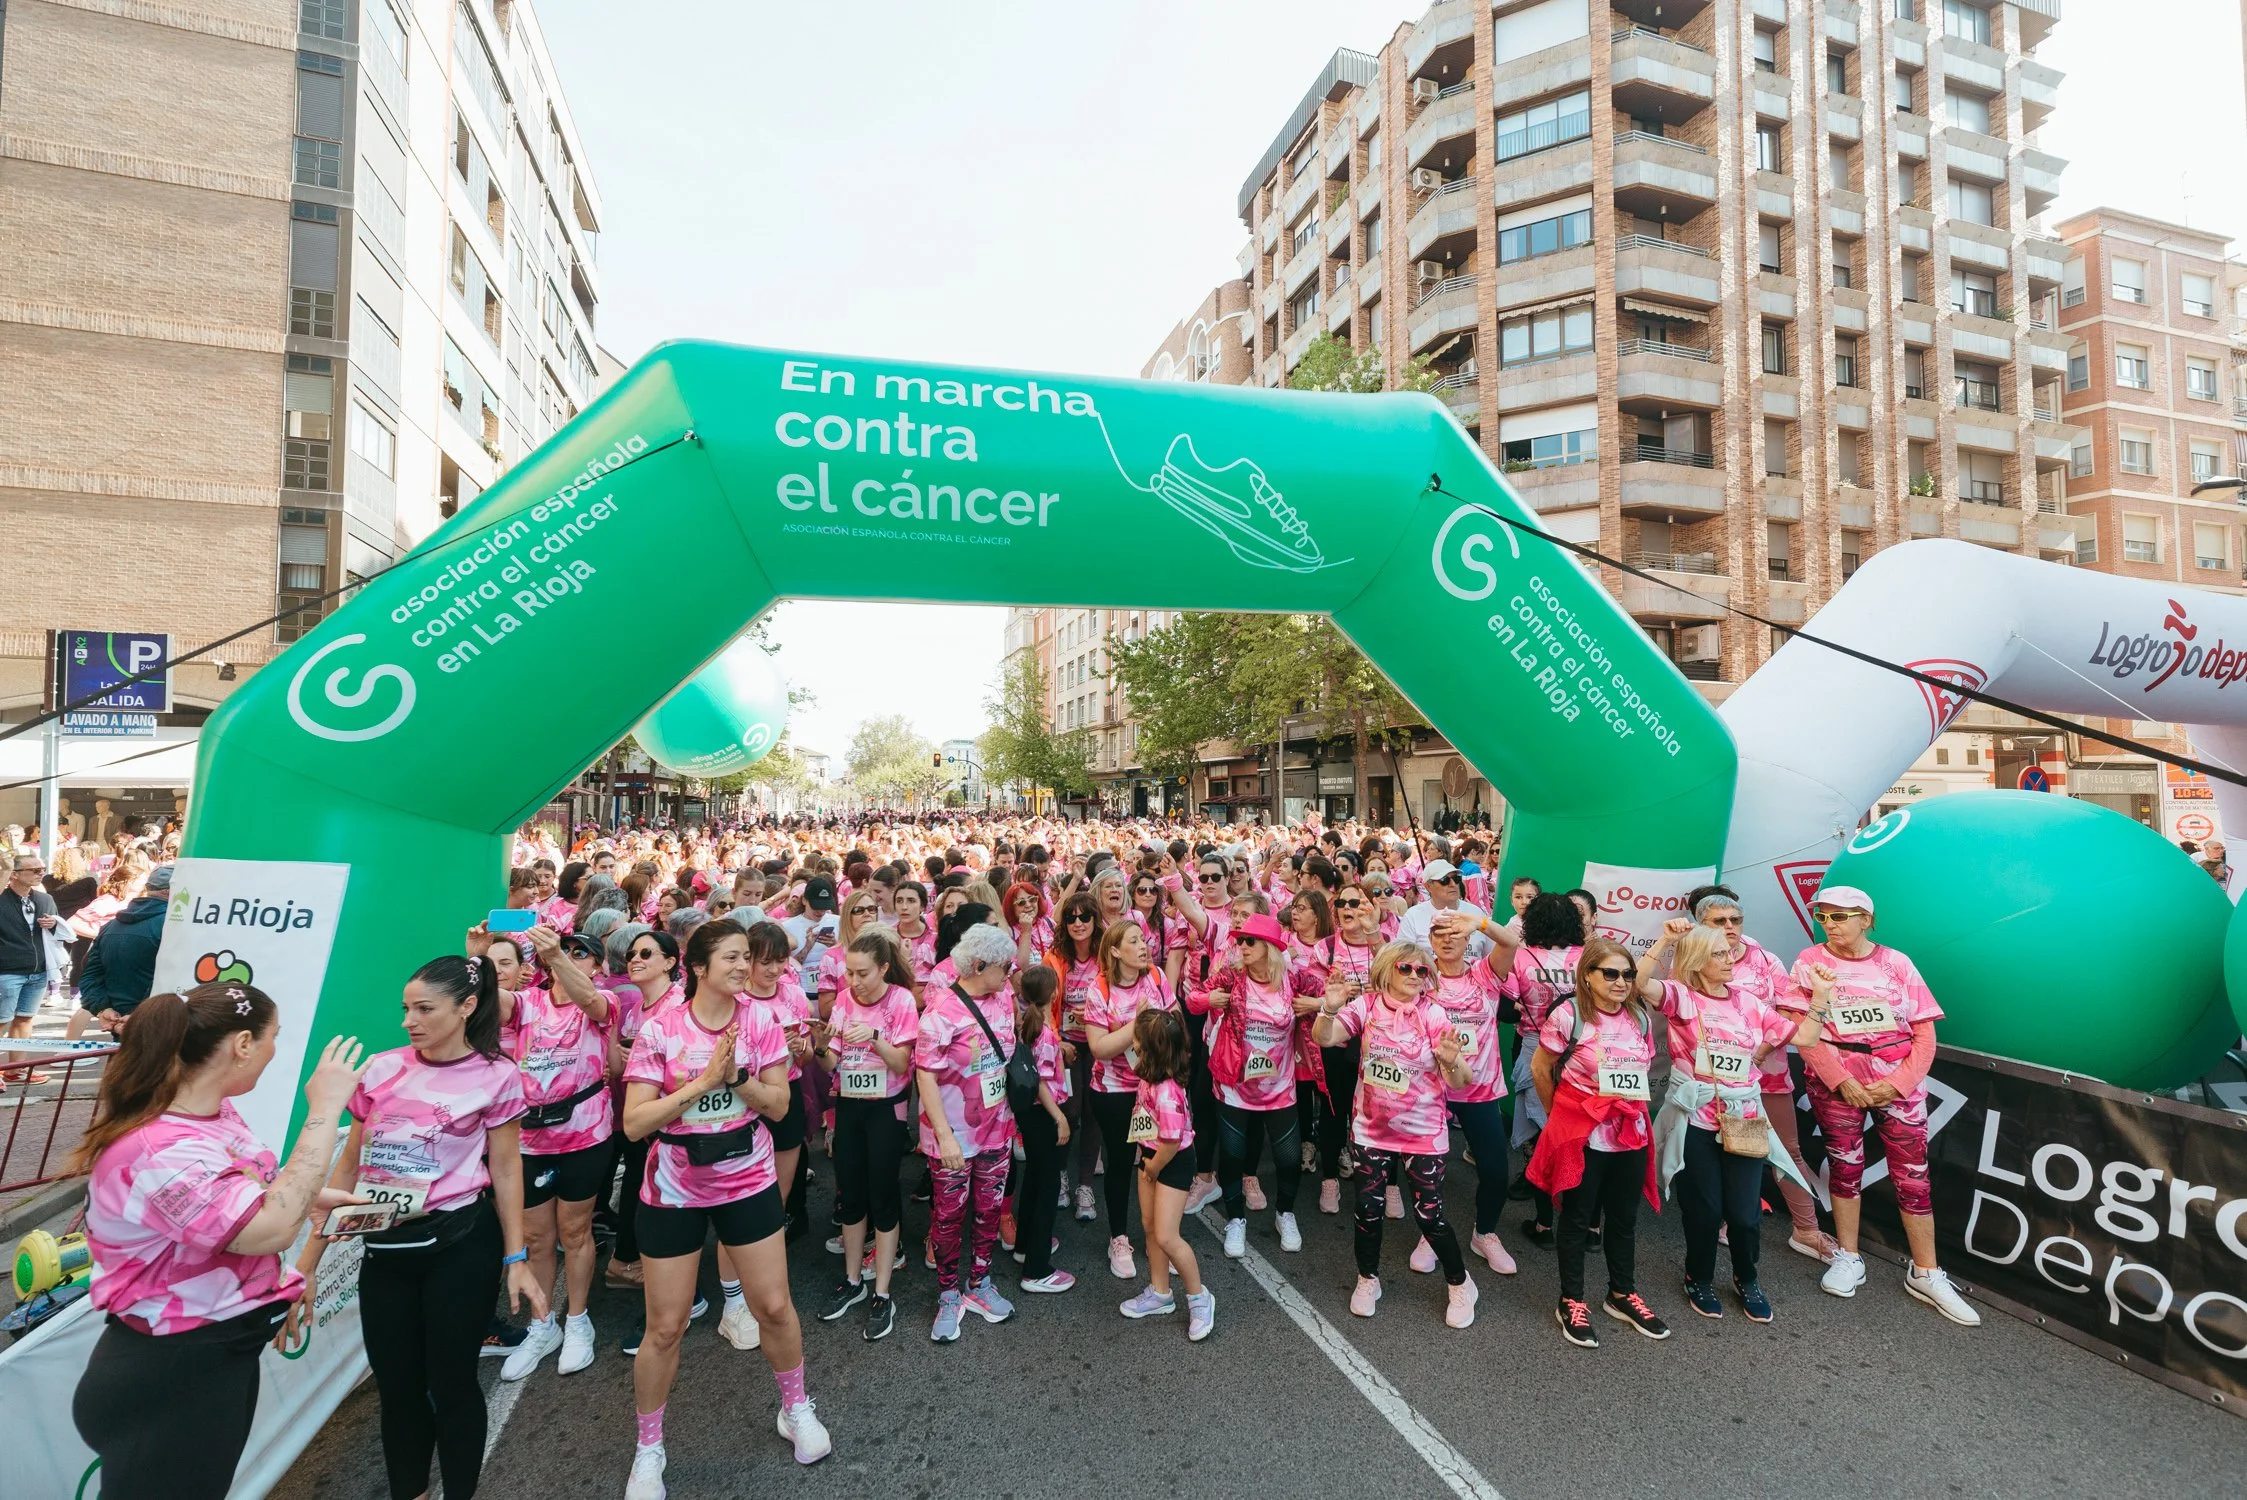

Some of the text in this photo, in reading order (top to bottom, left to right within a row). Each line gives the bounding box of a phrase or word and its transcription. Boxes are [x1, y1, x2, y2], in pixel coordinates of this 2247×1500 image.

[780, 360, 1099, 418] En marcha
[775, 411, 979, 462] contra
[776, 461, 1060, 527] el cáncer
[390, 433, 649, 624] asociación española
[782, 523, 1011, 546] ASOCIACIÓN ESPAÑOLA CONTRA EL CÁNCER
[411, 493, 619, 648] contra el cáncer
[436, 558, 597, 673] en La Rioja
[129, 640, 162, 674] P
[1510, 595, 1635, 739] contra el cáncer
[1529, 575, 1681, 757] asociación española
[1487, 614, 1581, 723] en La Rioja
[64, 713, 156, 727] LAVADO A MANO
[83, 727, 113, 735] INTERIOR
[113, 727, 126, 735] DEL
[2091, 774, 2124, 784] TEXTILES
[192, 896, 314, 933] La Rioja
[1841, 1007, 1884, 1025] 5505
[1704, 1026, 1713, 1034] XI
[1369, 1042, 1399, 1054] Carrera
[1706, 1036, 1738, 1046] Carrera
[687, 1068, 698, 1079] XI
[1371, 1063, 1402, 1083] 1250
[1709, 1054, 1743, 1073] 1237
[847, 1073, 877, 1089] 1031
[1609, 1073, 1641, 1089] 1252
[698, 1091, 733, 1113] 869
[371, 1140, 408, 1151] Carrera
[371, 1151, 396, 1162] por la
[1964, 1188, 2247, 1359] Depo
[313, 1278, 341, 1309] contra
[318, 1309, 332, 1328] en
